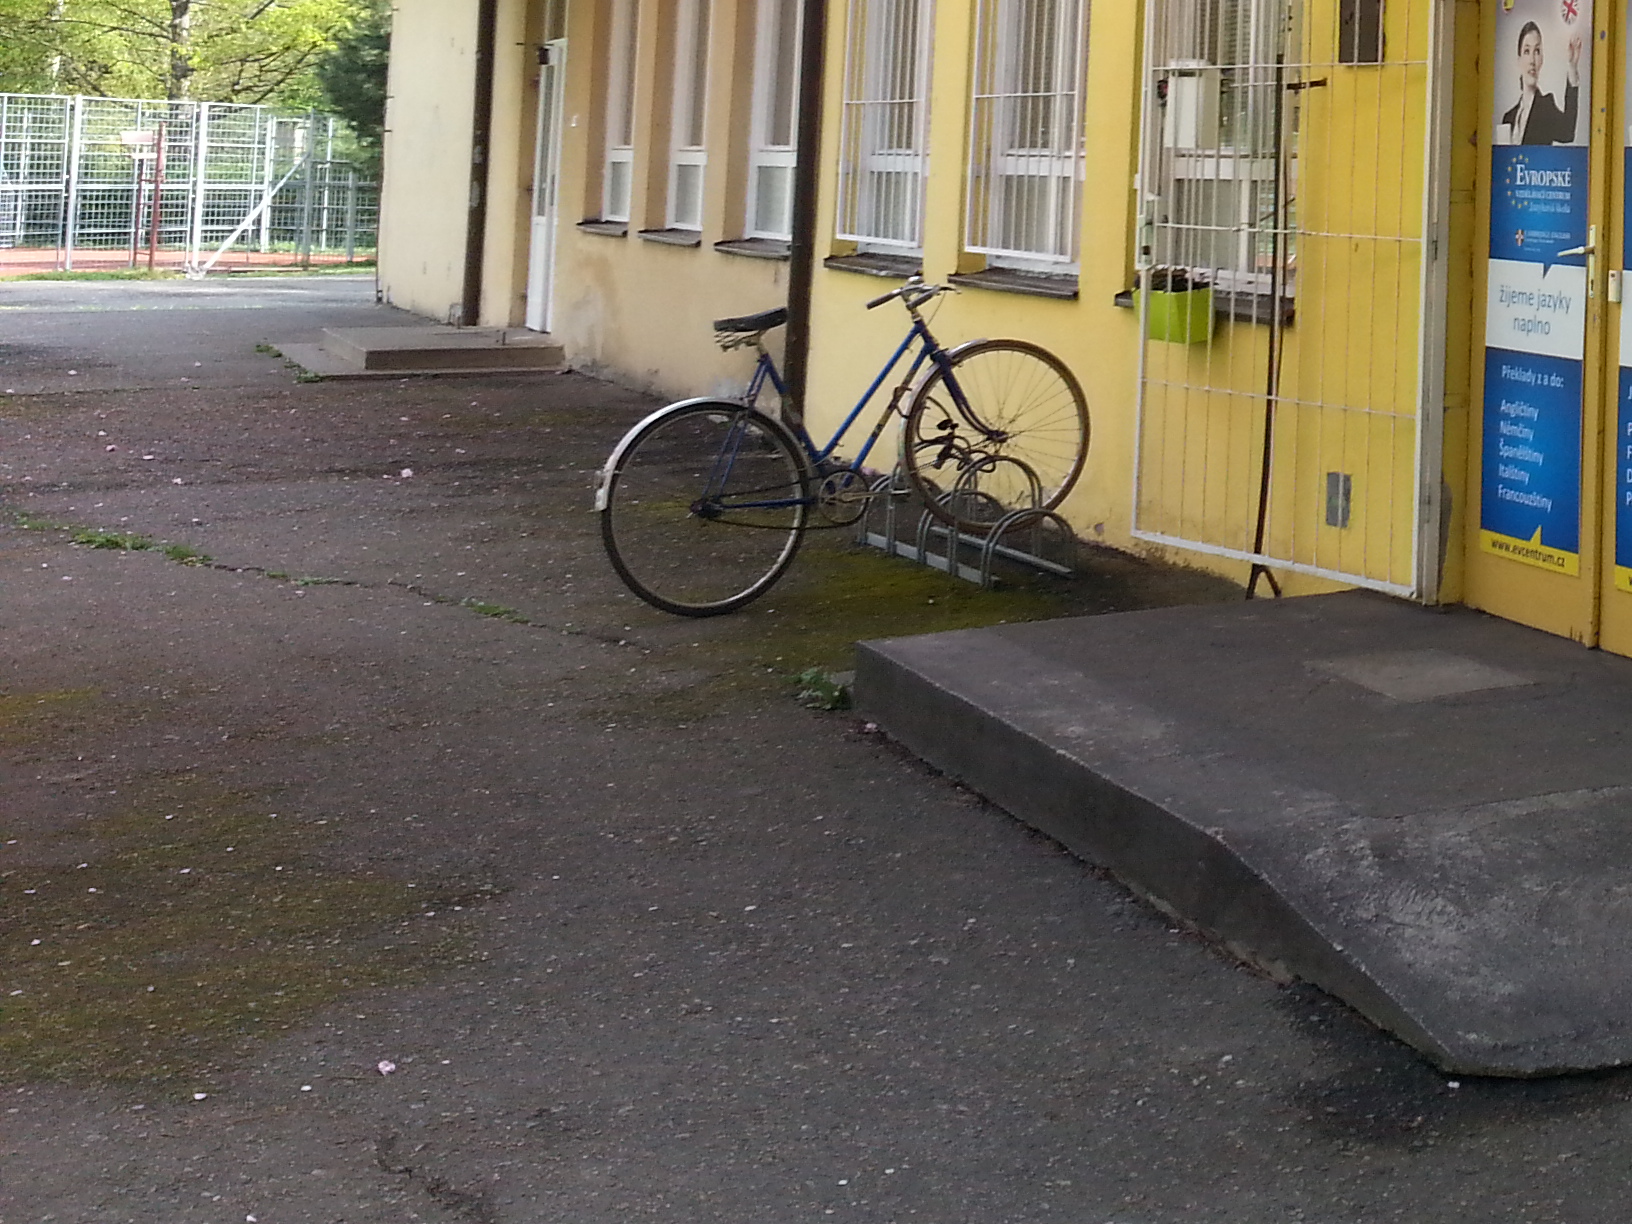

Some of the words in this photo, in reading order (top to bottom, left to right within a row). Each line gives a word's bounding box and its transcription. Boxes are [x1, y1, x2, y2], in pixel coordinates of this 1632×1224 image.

[1499, 284, 1534, 307] žijeme
[1536, 289, 1572, 314] jazyky
[1513, 315, 1551, 336] naplno
[1501, 364, 1536, 386] Překlady
[1537, 373, 1542, 385] z
[1543, 374, 1549, 386] a
[1550, 372, 1564, 388] do:
[1500, 399, 1539, 422] Angličtiny
[1499, 420, 1534, 442] Němčiny
[1491, 539, 1566, 568] www.evcentrum.cz
